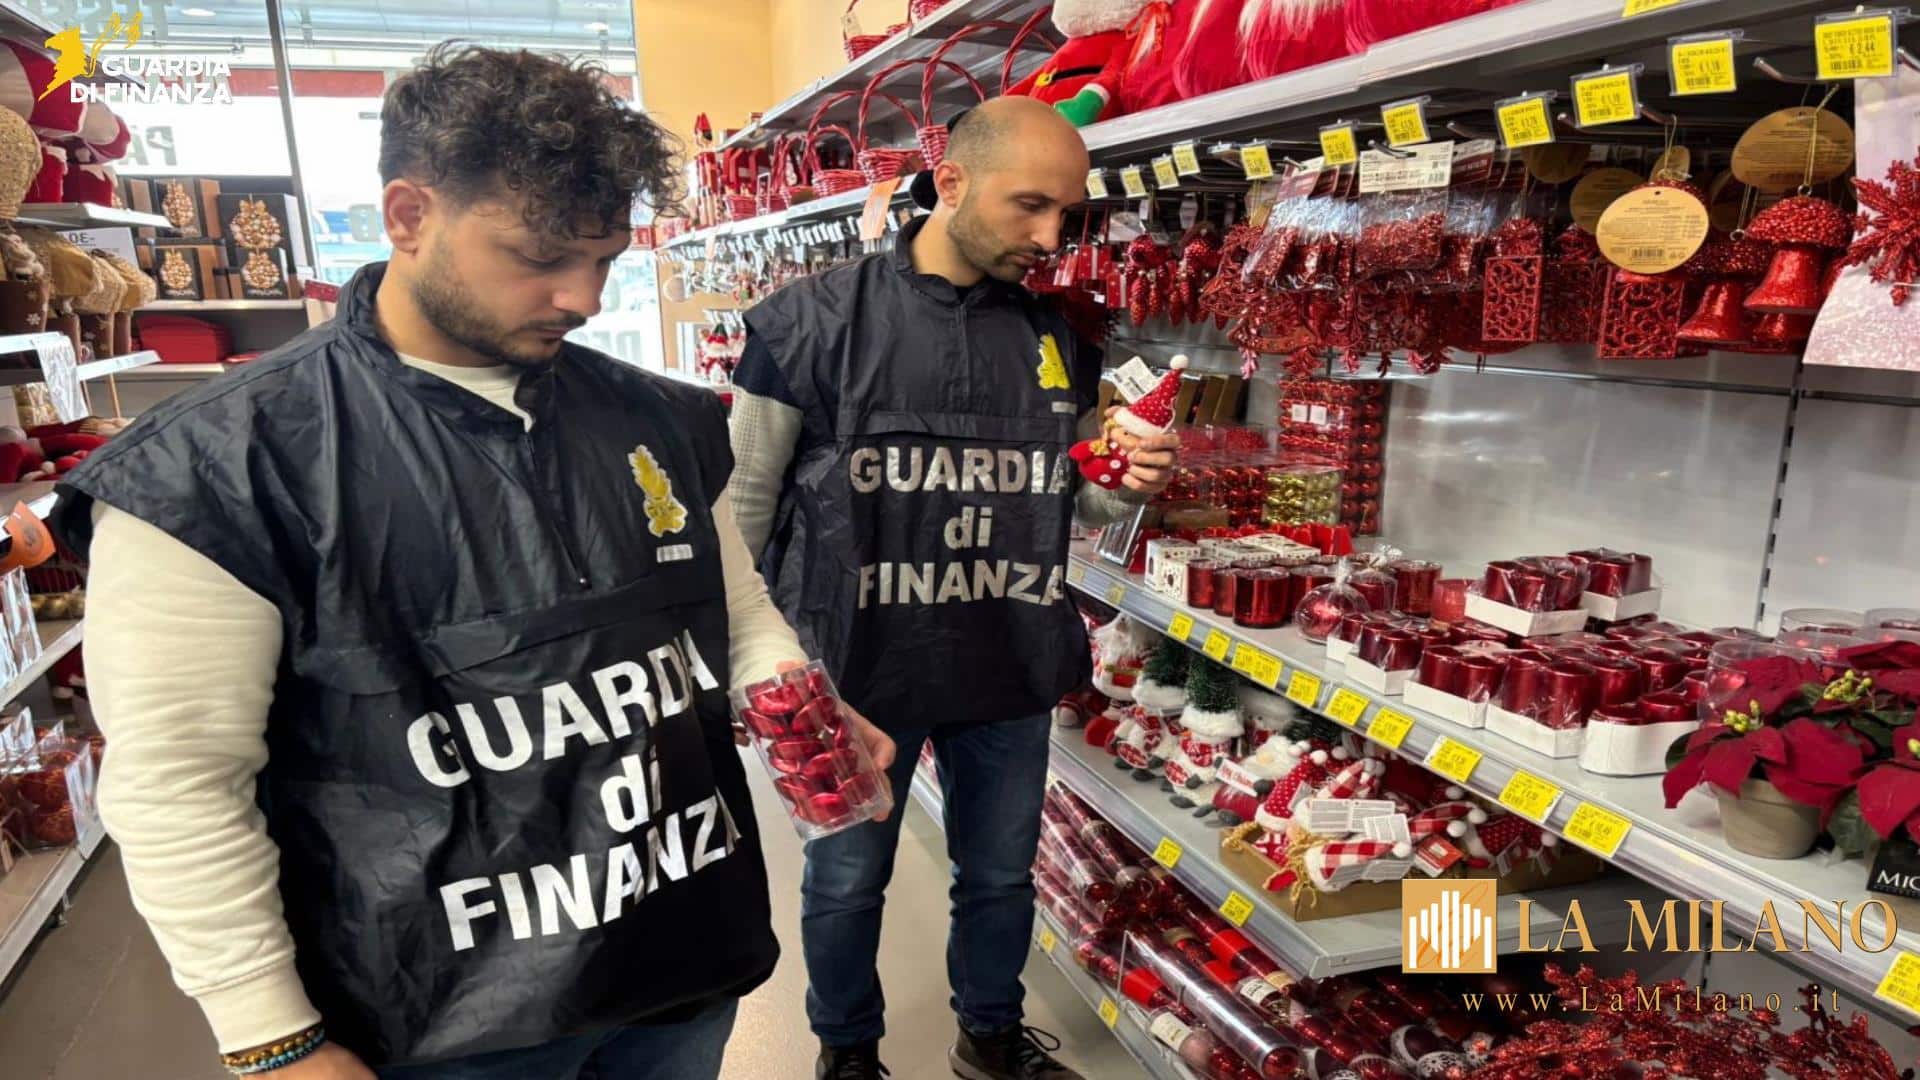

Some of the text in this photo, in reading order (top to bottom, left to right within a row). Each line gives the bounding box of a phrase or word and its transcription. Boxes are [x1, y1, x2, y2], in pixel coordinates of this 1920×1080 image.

[850, 447, 1070, 494] GUARDIA
[943, 506, 993, 549] di
[858, 559, 1064, 609] FINANZA
[601, 744, 662, 833] di
